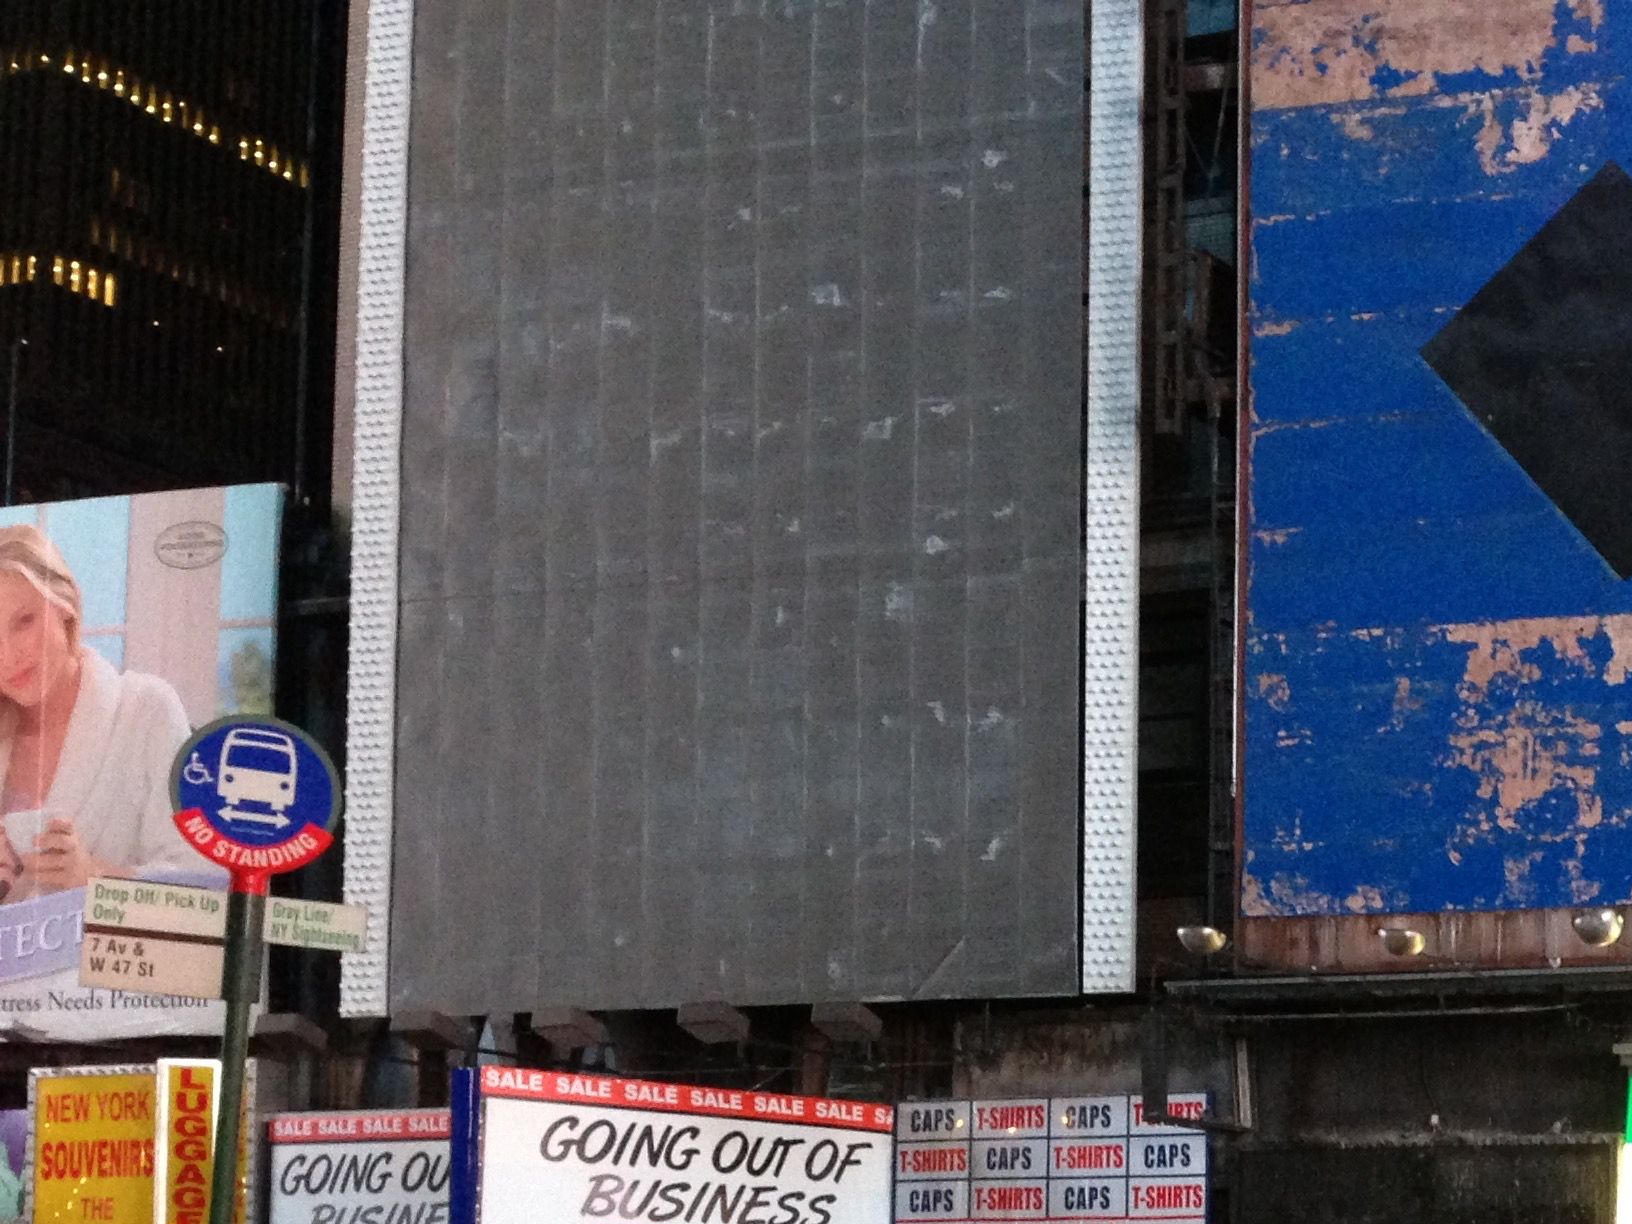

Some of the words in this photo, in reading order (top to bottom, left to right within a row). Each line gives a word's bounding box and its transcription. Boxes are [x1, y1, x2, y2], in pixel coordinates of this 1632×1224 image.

[184, 815, 214, 845] NO
[212, 832, 319, 868] STANDING
[94, 883, 129, 904] Drop
[164, 890, 195, 909] Pick
[200, 895, 220, 913] Up
[272, 902, 299, 920] Gray
[92, 904, 126, 924] Only
[270, 923, 289, 938] NY
[91, 938, 100, 952] 7
[107, 940, 127, 955] Av
[132, 940, 145, 957] &
[89, 957, 106, 974] W
[111, 959, 131, 974] 47
[137, 961, 154, 978] St
[47, 990, 103, 1011] Needs
[44, 1093, 91, 1123] NEW
[94, 1091, 150, 1122] YORK
[485, 1068, 544, 1092] SALE
[555, 1076, 613, 1098] SALE
[623, 1082, 679, 1105] SALE
[690, 1090, 743, 1111] SALE
[753, 1095, 805, 1116] SALE
[815, 1102, 864, 1122] SALE
[272, 1120, 312, 1137] SALE
[318, 1118, 357, 1136] SALE
[362, 1117, 402, 1134] SALE
[408, 1115, 448, 1133] SALE
[910, 1107, 956, 1133] CAPS
[976, 1104, 1045, 1131] T-SHIRTS
[1064, 1104, 1112, 1130] CAPS
[40, 1138, 155, 1181] SOUVENIRS
[540, 1114, 701, 1171] GOING
[711, 1130, 806, 1180] OUT
[804, 1138, 874, 1184] OF
[899, 1147, 967, 1173] T-SHIRTS
[986, 1146, 1032, 1171] CAPS
[1054, 1143, 1124, 1170] T-SHIRTS
[1143, 1142, 1192, 1169] CAPS
[279, 1151, 394, 1197] GOING
[401, 1150, 451, 1194] OU
[80, 1196, 114, 1221] THE
[909, 1188, 954, 1214] CAPS
[974, 1186, 1043, 1211] T-SHIRTS
[1064, 1185, 1111, 1211] CAPS
[1131, 1184, 1203, 1210] T-SHIRTS
